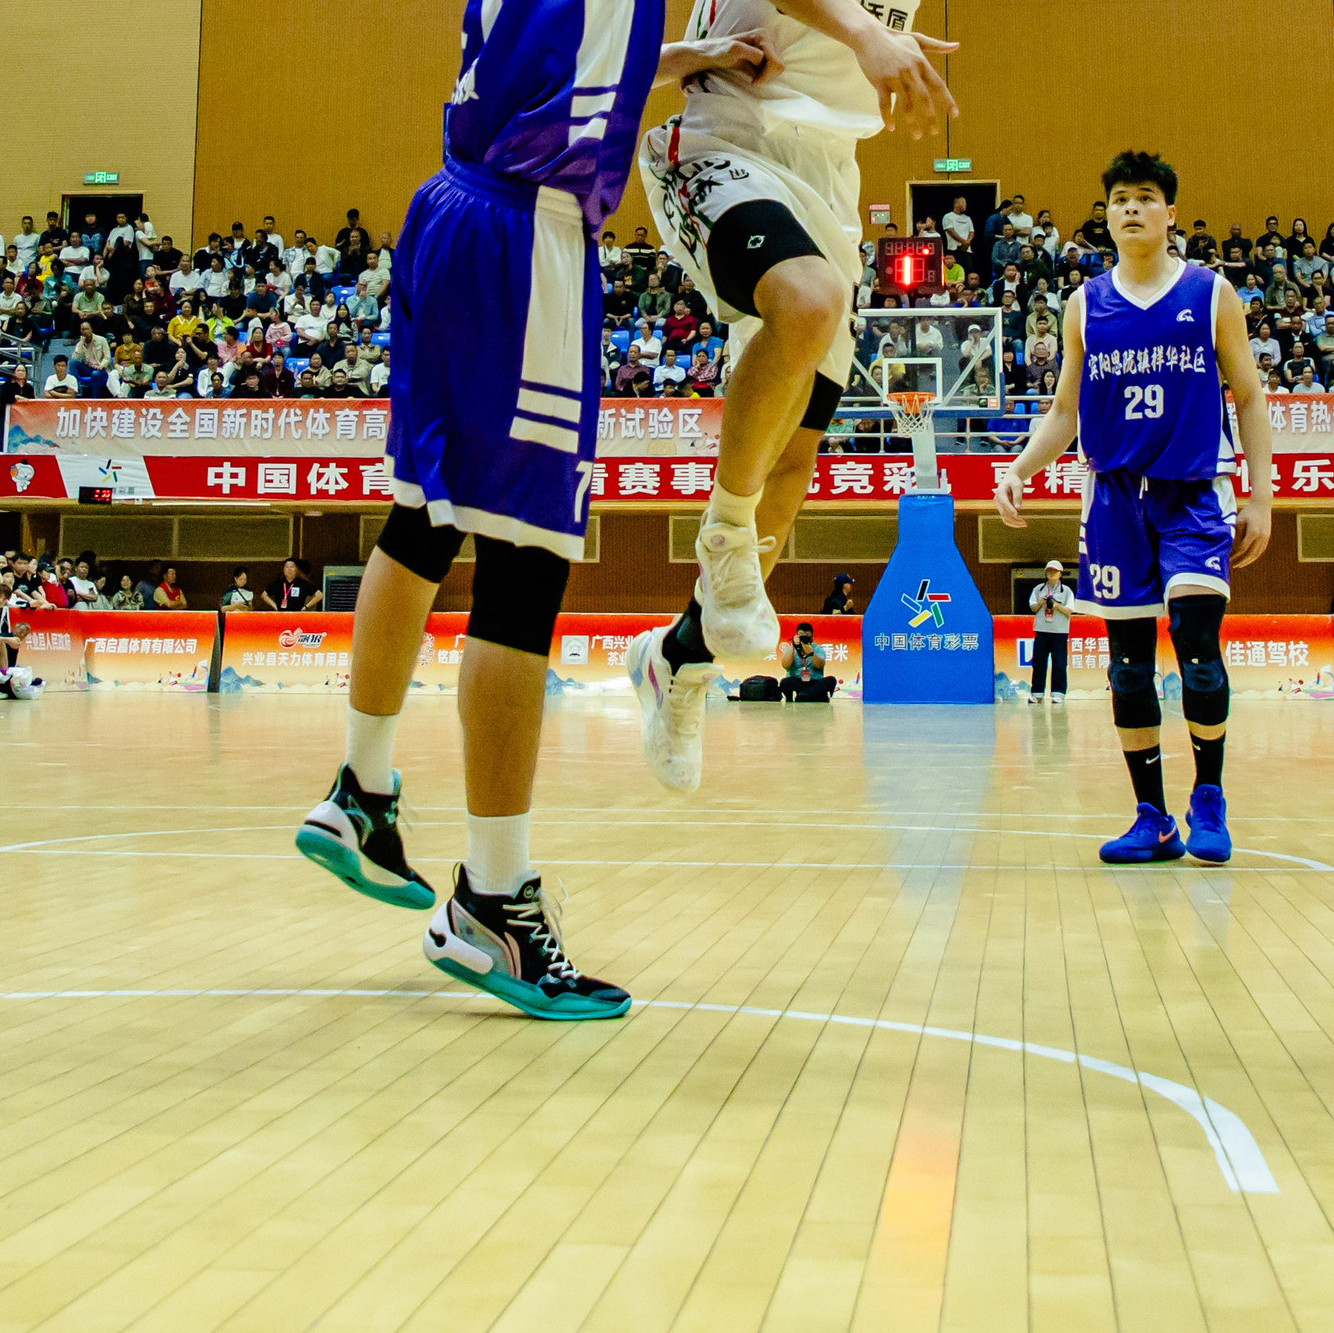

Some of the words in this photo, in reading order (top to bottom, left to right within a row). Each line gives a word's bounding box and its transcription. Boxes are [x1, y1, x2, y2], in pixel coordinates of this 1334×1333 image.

[1088, 345, 1206, 381] 宾阳思陇镇祥华社区
[1124, 384, 1164, 420] 29
[56, 407, 387, 440] 加快建设全国新时代体育高
[207, 462, 394, 495] 中国体育
[1090, 564, 1120, 599] 29
[84, 638, 197, 655] 广西启嘉体育有限公司
[241, 651, 351, 666] 兴业县天力体育用品
[874, 633, 979, 652] 中国体育彩票
[1225, 641, 1309, 667] 佳通驾校
